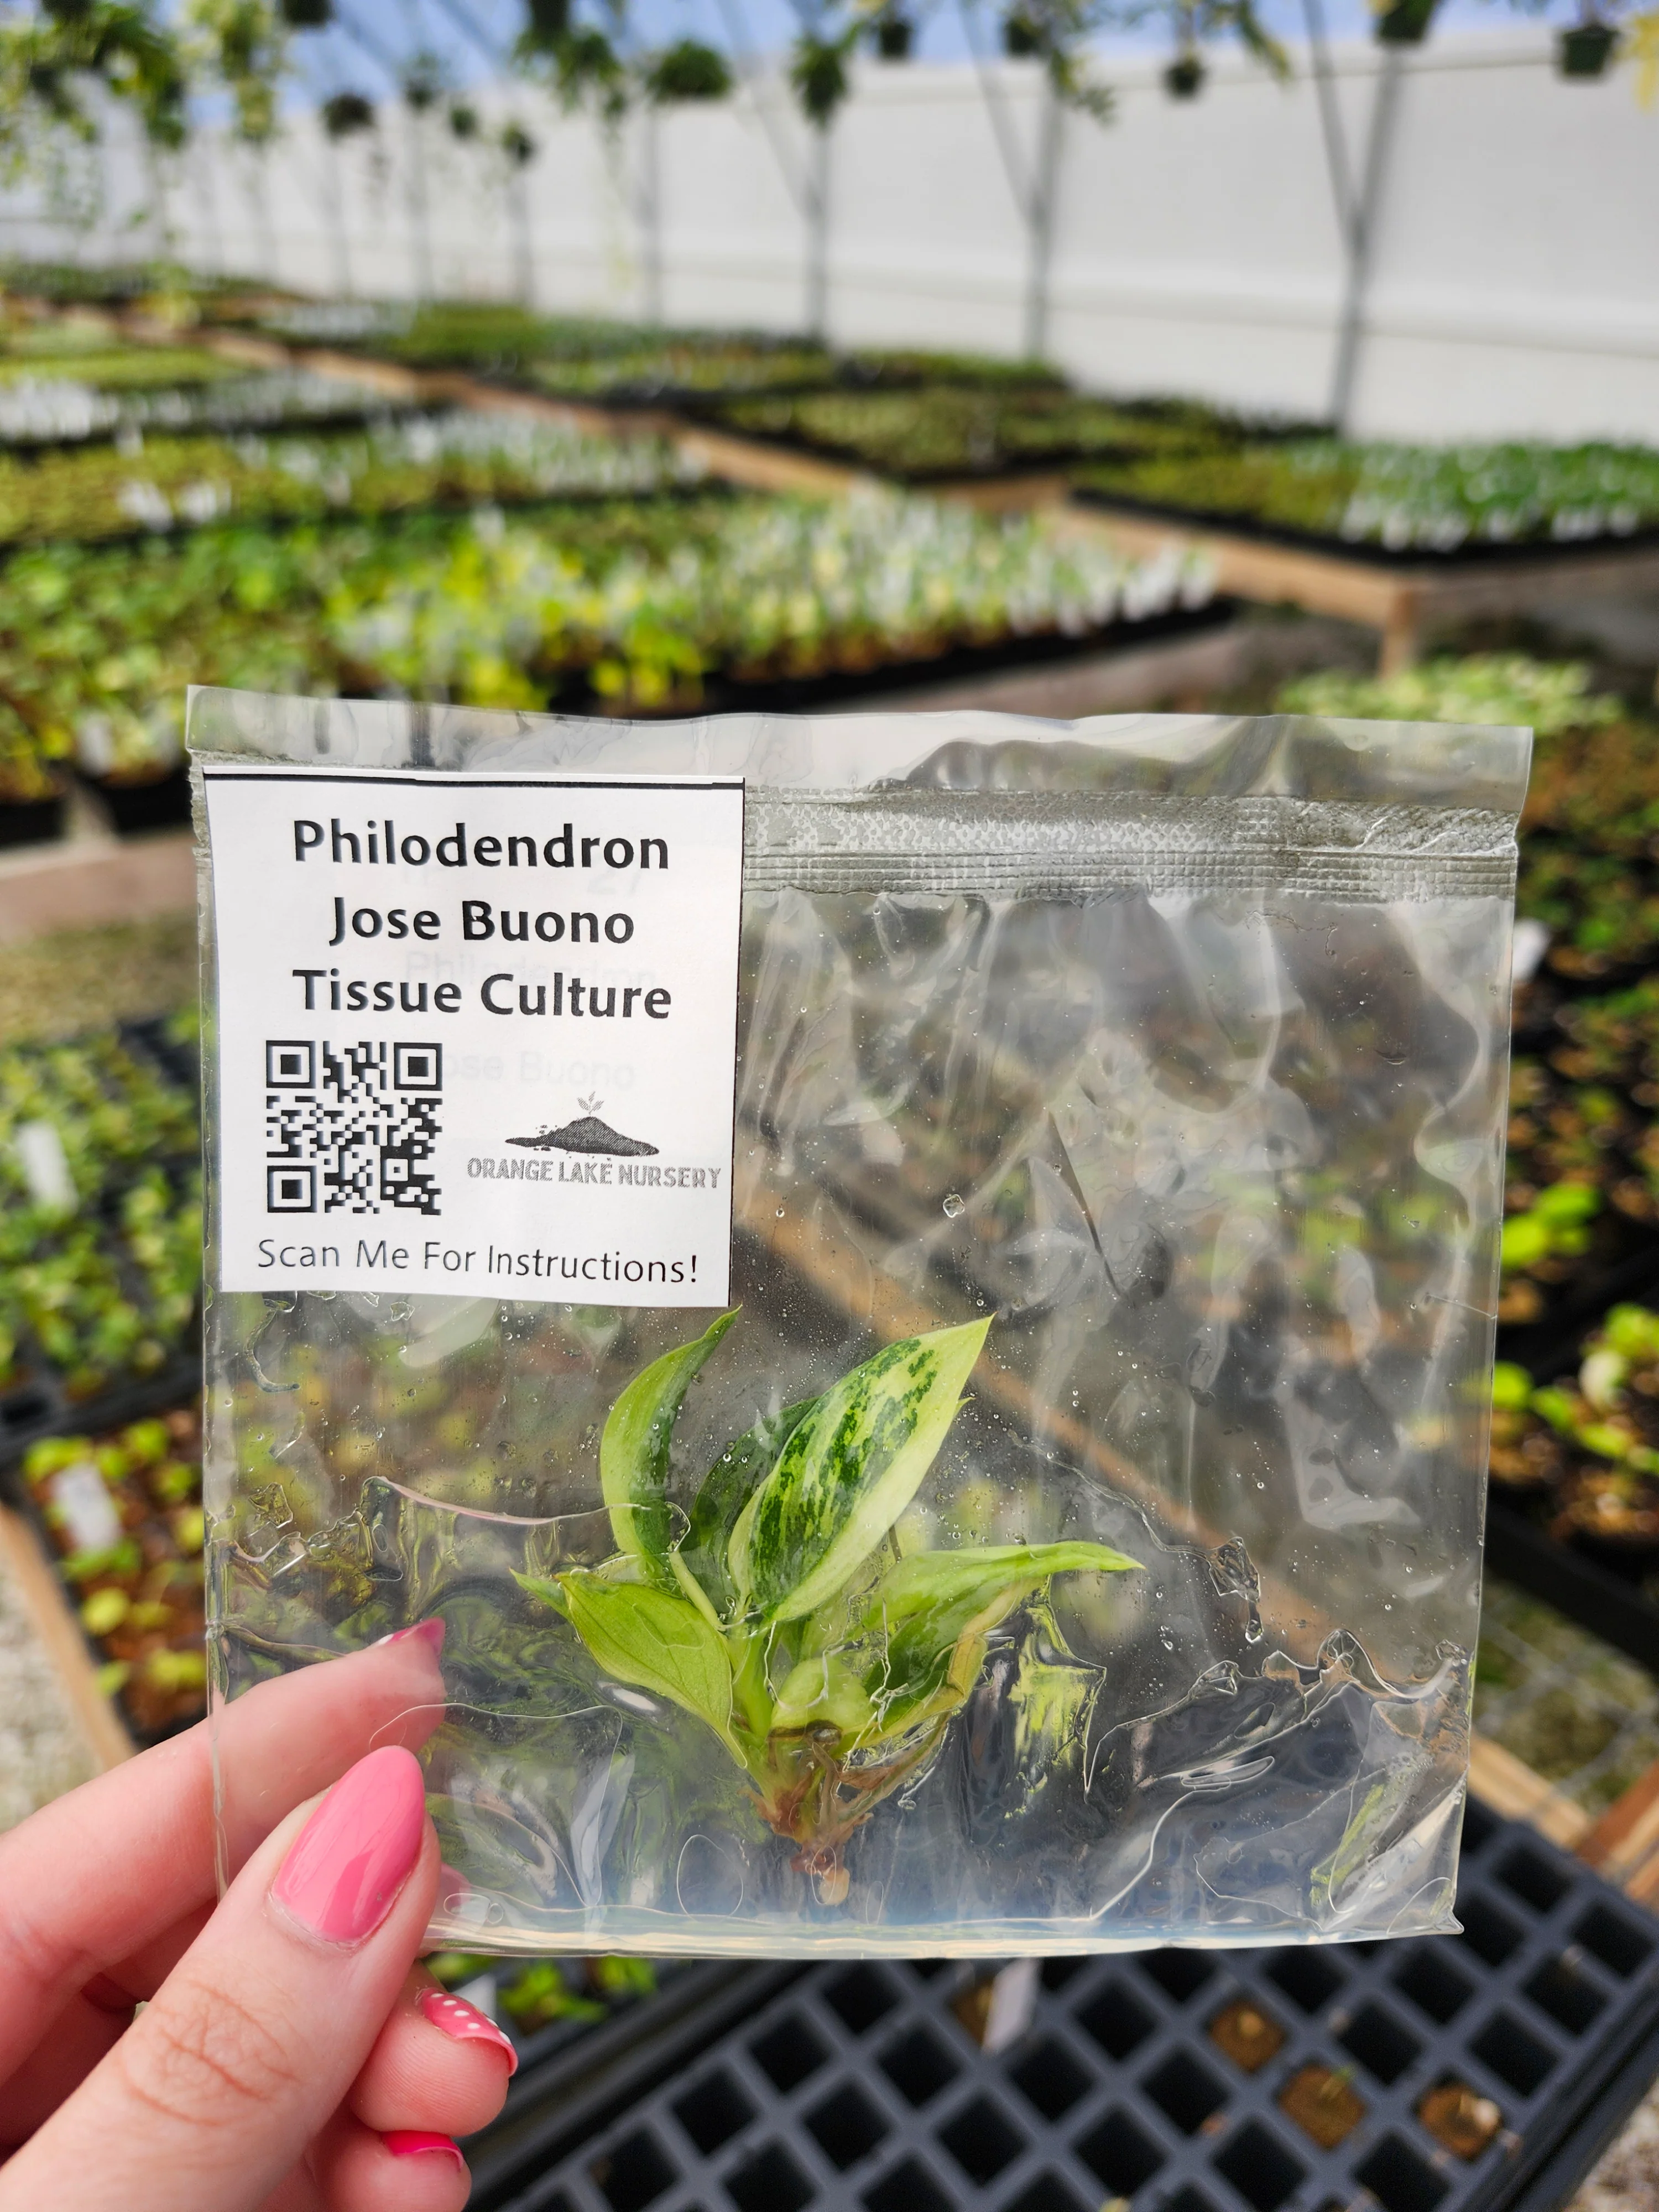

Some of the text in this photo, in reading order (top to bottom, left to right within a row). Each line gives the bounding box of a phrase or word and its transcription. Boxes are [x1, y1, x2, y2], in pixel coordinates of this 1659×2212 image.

[294, 818, 668, 869] Philodendron
[329, 897, 634, 946] Jose Buono
[293, 968, 671, 1019] Tissue Culture
[437, 1053, 504, 1082] ose
[468, 1158, 721, 1188] ORANGE LAKE NURSERY
[259, 1239, 696, 1282] Scan Me For Instructions!
